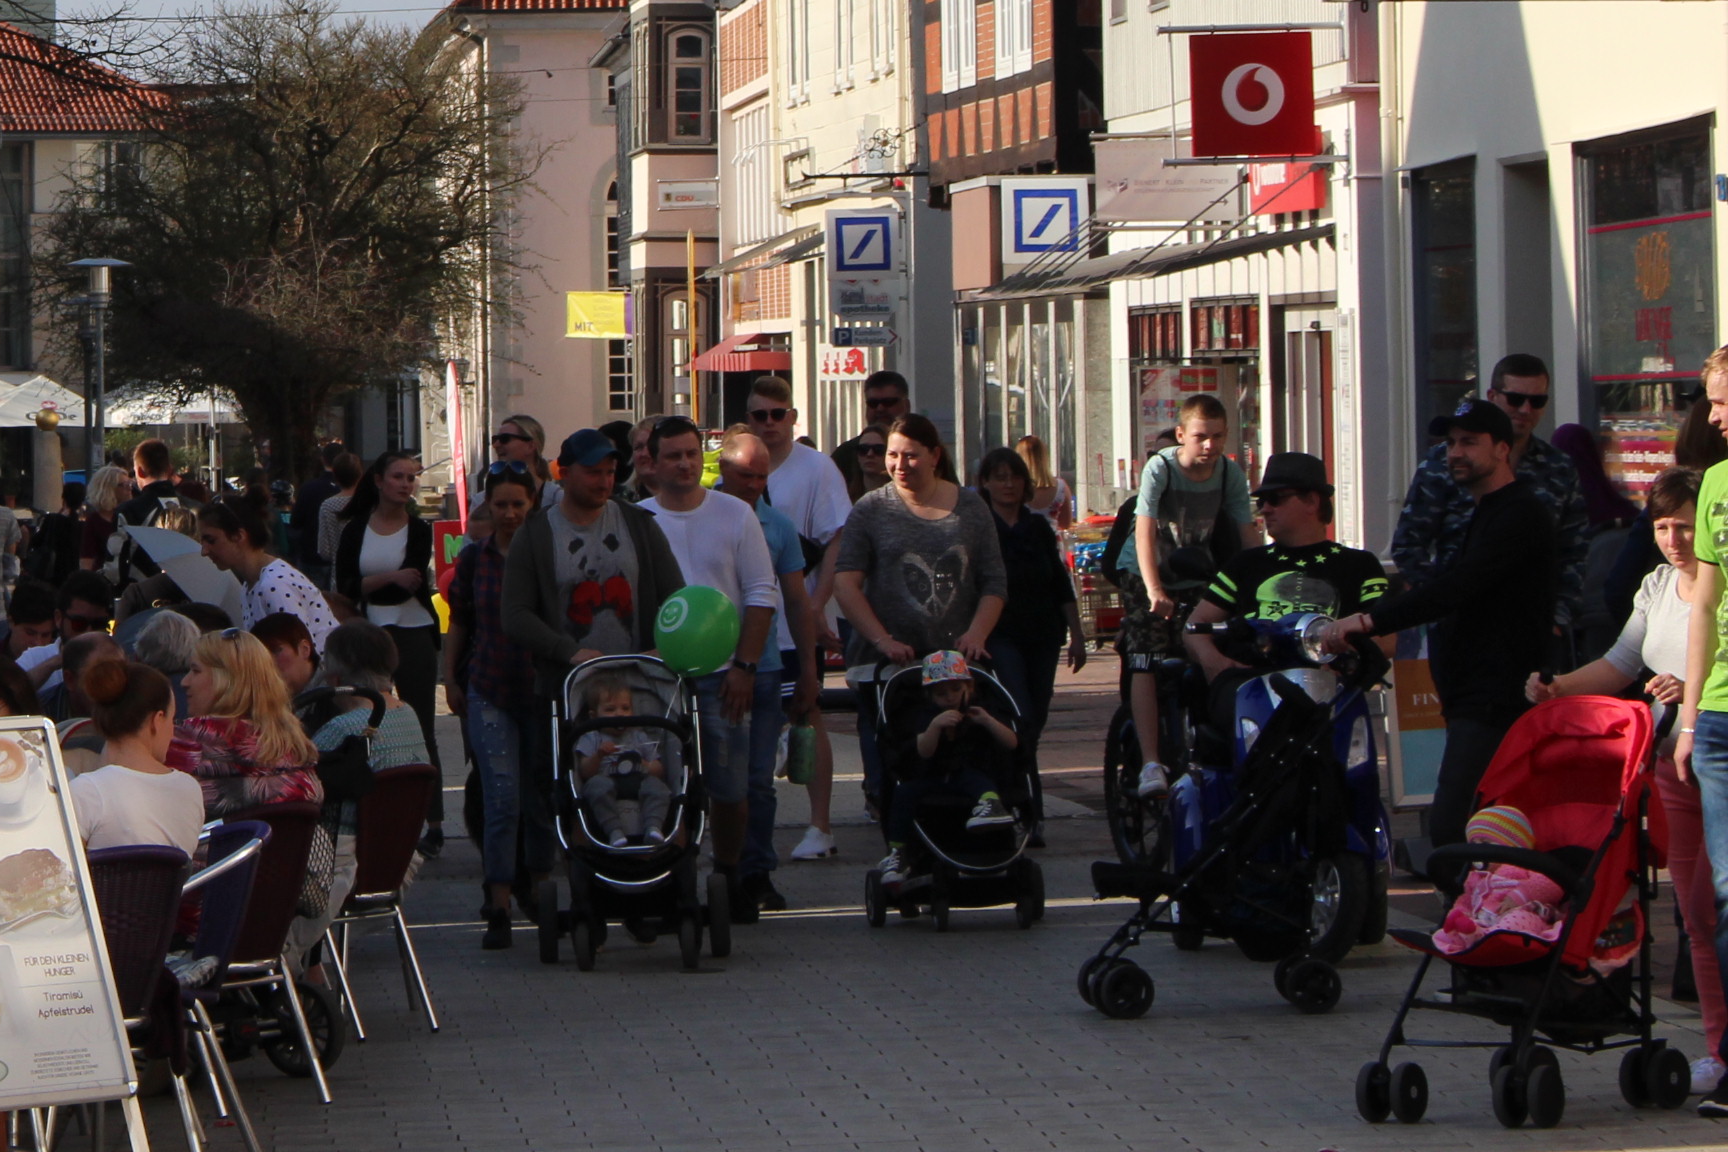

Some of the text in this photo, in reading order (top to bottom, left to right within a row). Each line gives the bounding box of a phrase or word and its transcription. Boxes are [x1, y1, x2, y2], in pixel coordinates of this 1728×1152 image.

[574, 321, 594, 332] MIT
[838, 330, 850, 345] P
[23, 953, 90, 967] FÜR DEN KLEINEN
[44, 966, 76, 977] HUNGER
[38, 1004, 94, 1020] Apfelstrudel
